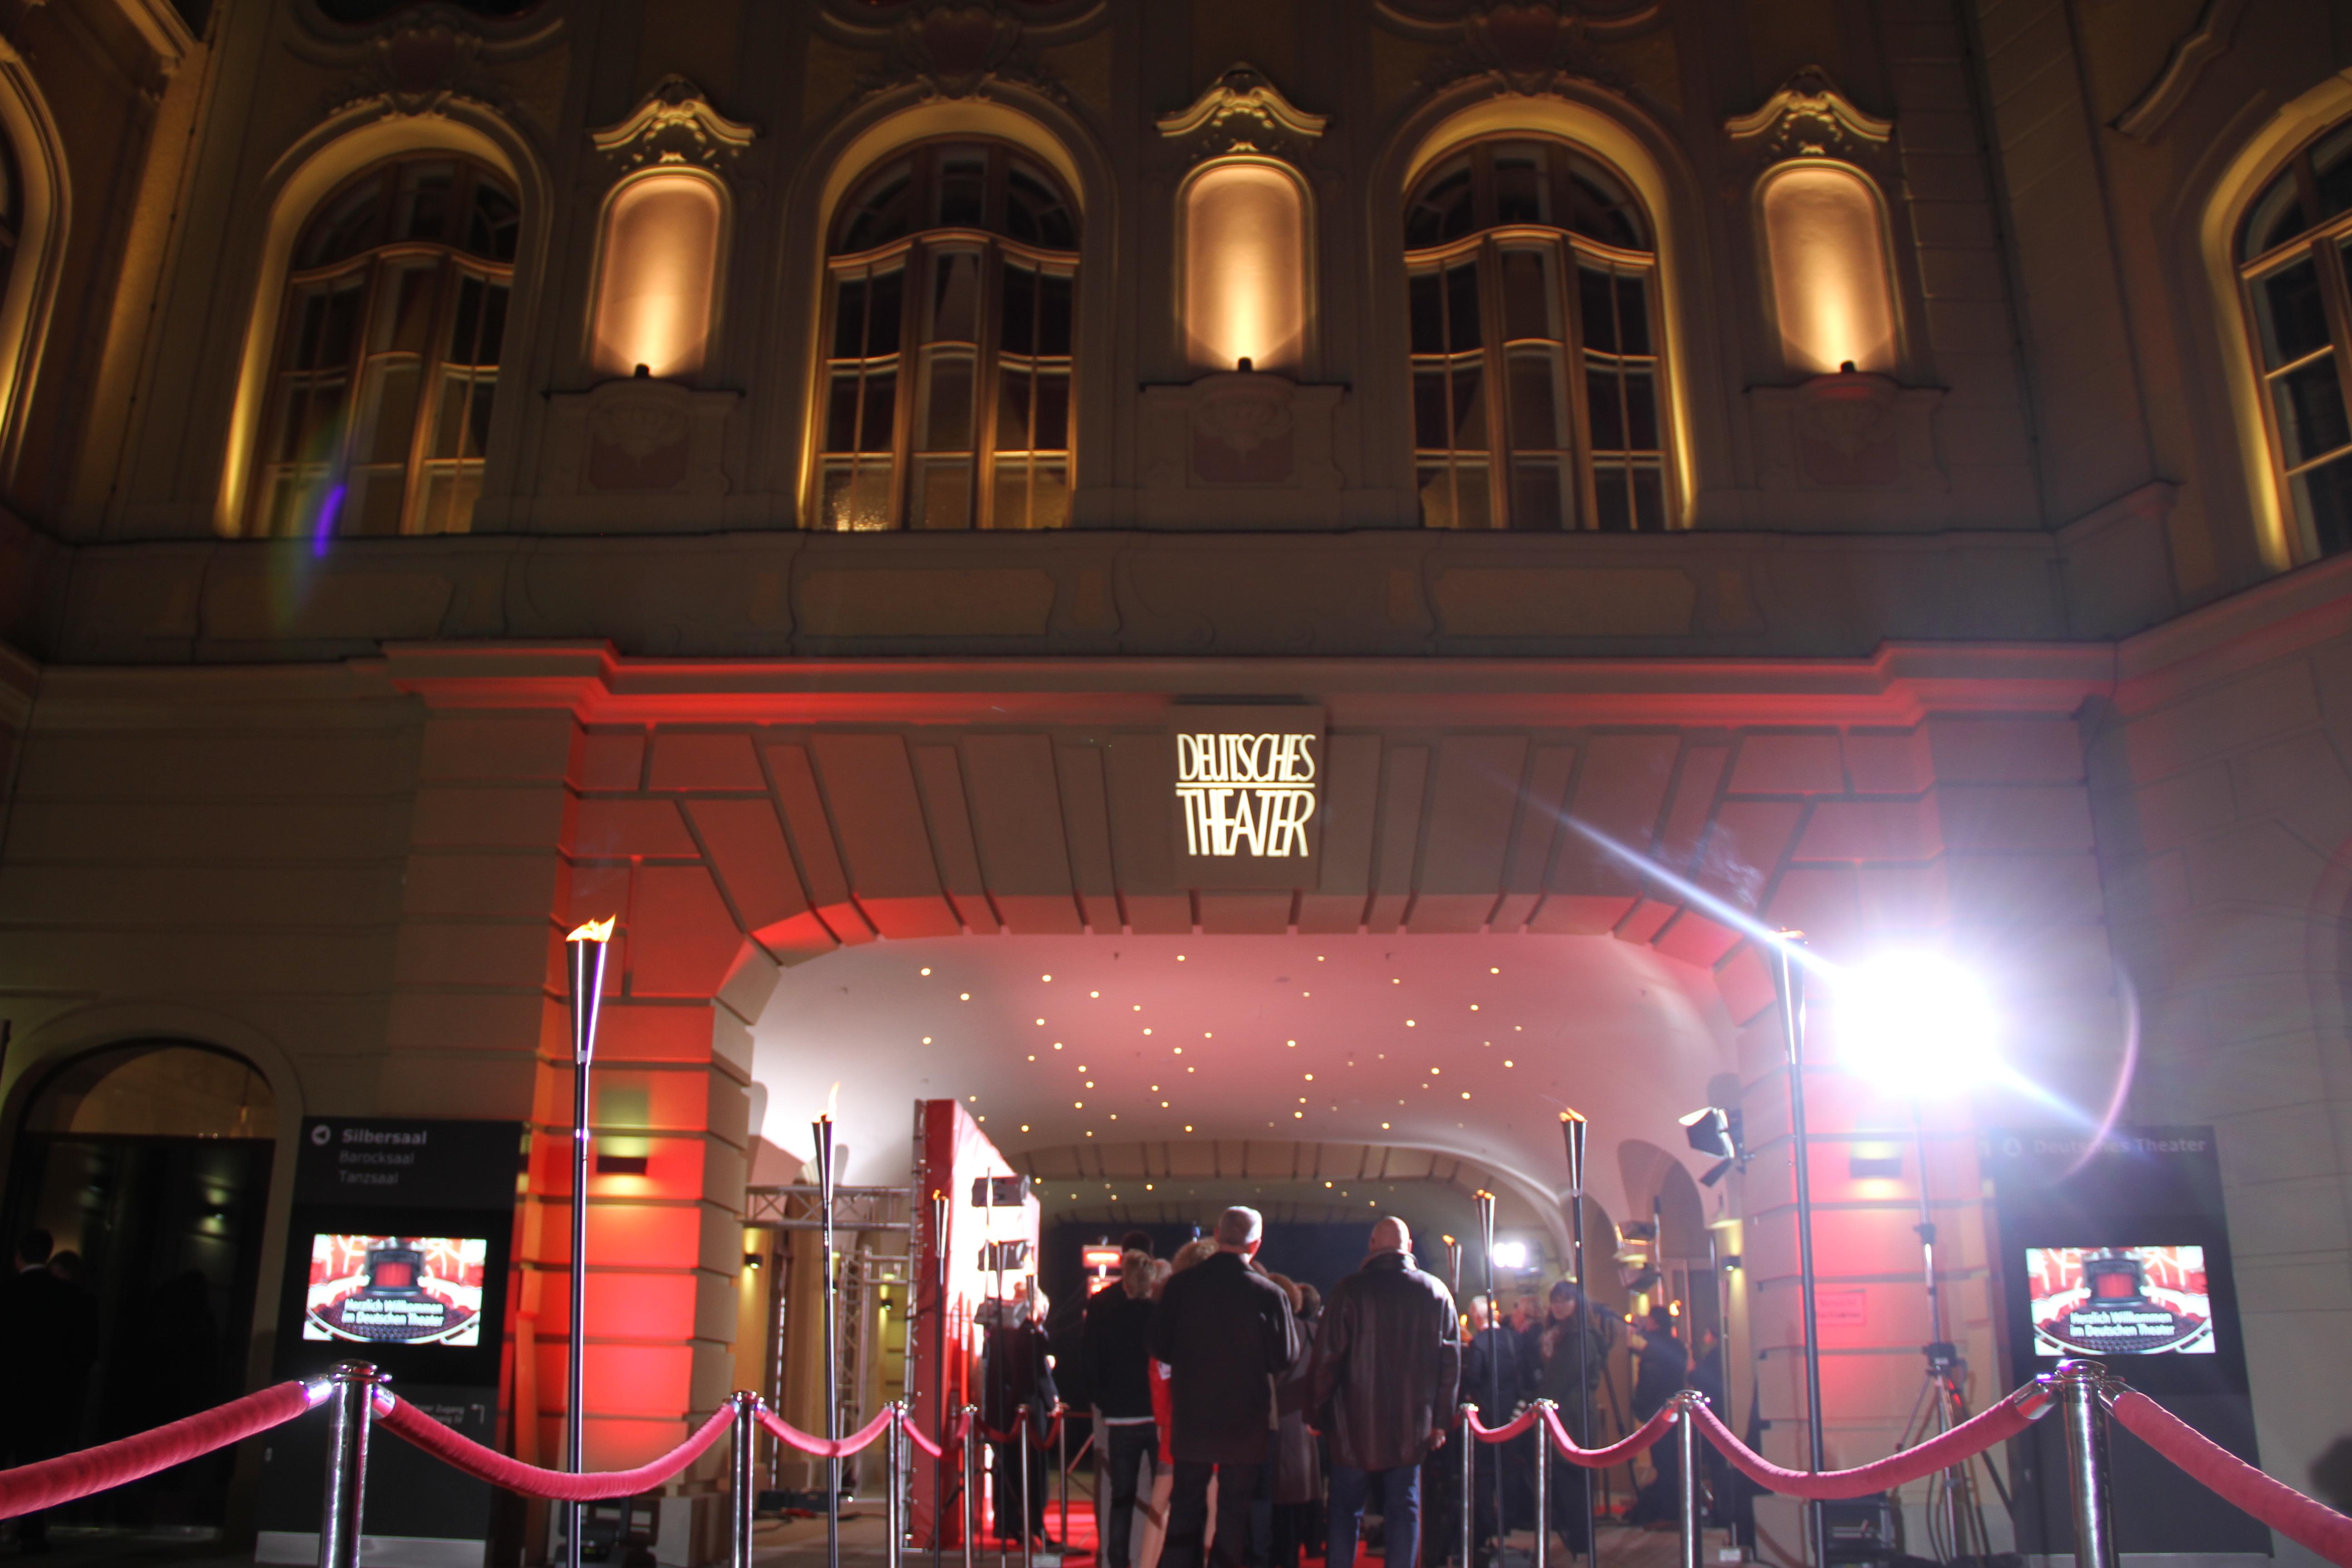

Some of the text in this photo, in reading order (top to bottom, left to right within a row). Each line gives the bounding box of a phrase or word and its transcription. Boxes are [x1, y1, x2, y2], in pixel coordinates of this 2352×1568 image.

[1177, 733, 1316, 782] DEUTSCHES
[1176, 789, 1315, 857] THEATER
[341, 1128, 427, 1145] Silbersaal
[2034, 1137, 2206, 1154] Deutses Theater
[339, 1149, 414, 1165] Barocksaal
[339, 1169, 399, 1184] Tanzsaal
[2110, 1311, 2172, 1323] Willkommen
